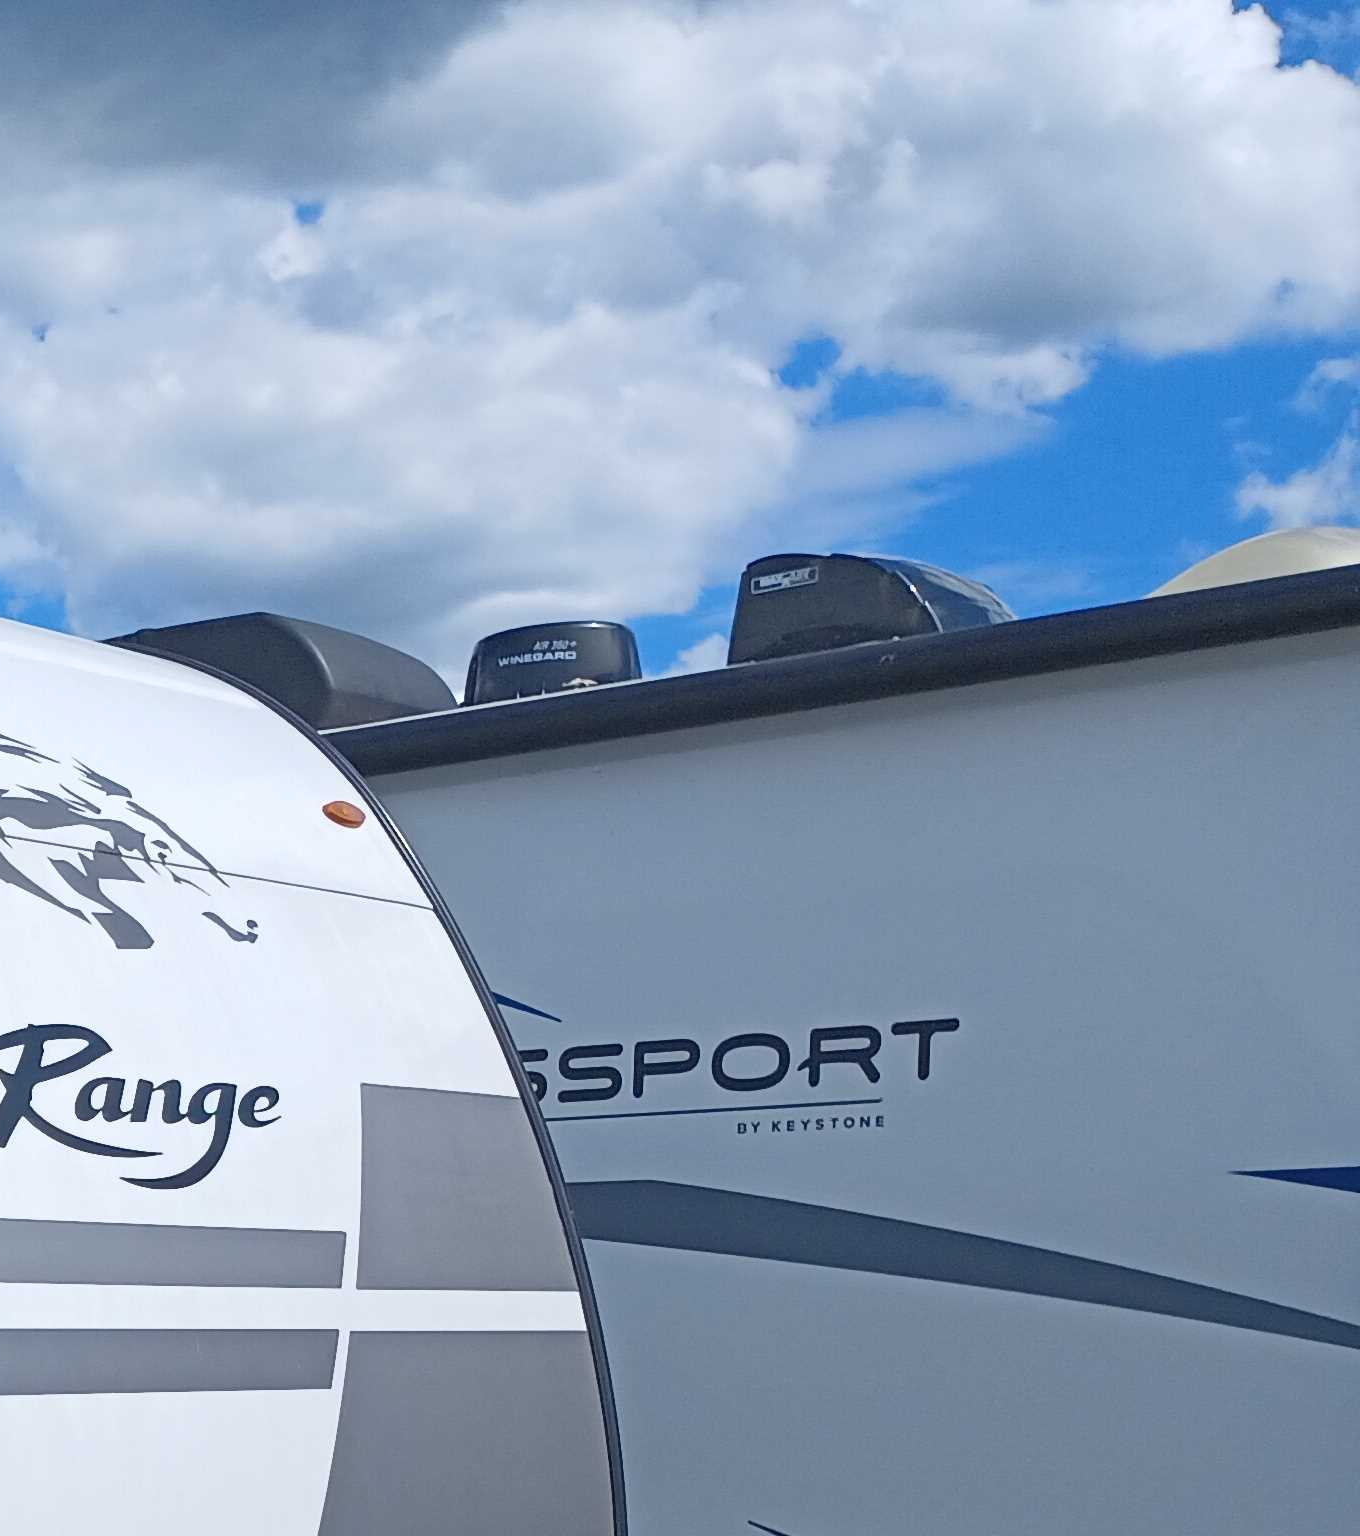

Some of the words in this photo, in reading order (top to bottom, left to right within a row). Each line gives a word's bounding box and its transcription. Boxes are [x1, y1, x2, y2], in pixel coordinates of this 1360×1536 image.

[498, 651, 577, 667] WINEGARD
[737, 1119, 761, 1135] BY
[772, 1115, 885, 1133] KEYSTONE
